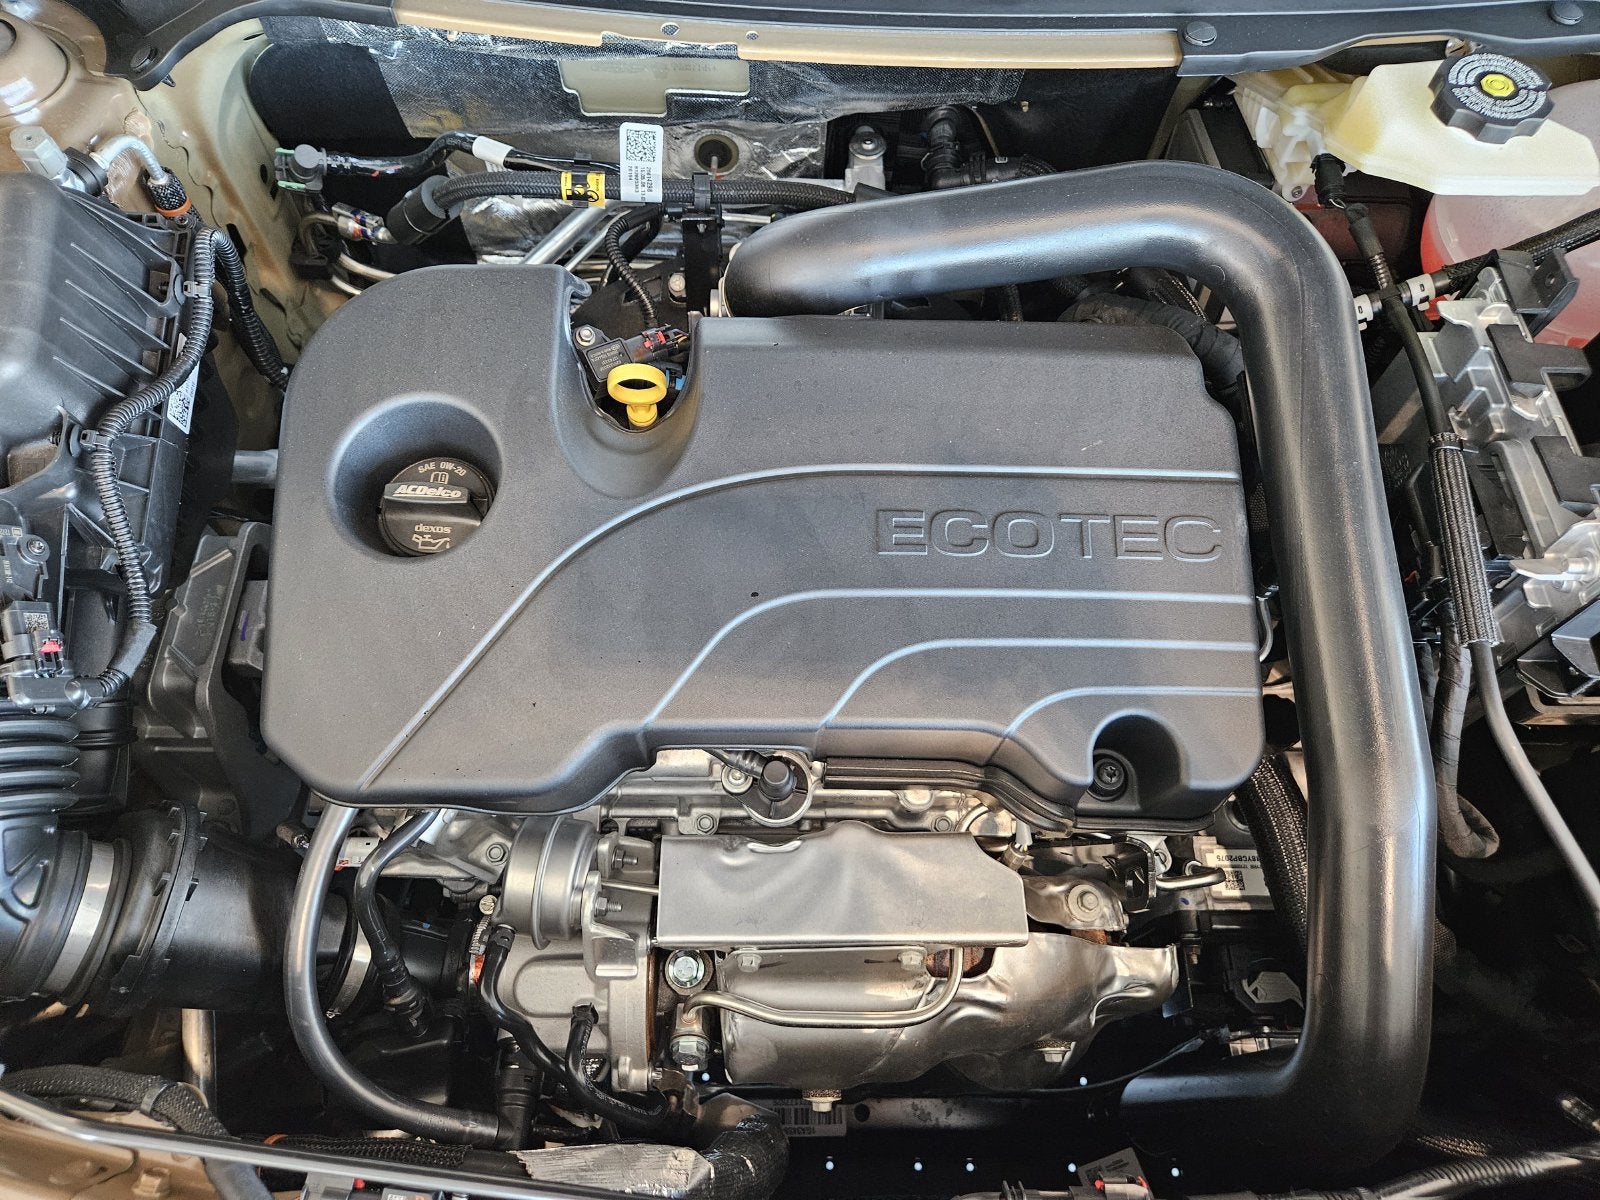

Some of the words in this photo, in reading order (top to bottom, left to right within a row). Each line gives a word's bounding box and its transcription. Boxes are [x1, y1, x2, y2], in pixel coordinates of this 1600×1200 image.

[418, 461, 436, 473] SAE
[440, 461, 467, 476] 0W-20
[392, 484, 462, 498] ACDelco
[414, 523, 453, 534] dexos
[875, 509, 1222, 562] ECOTEC
